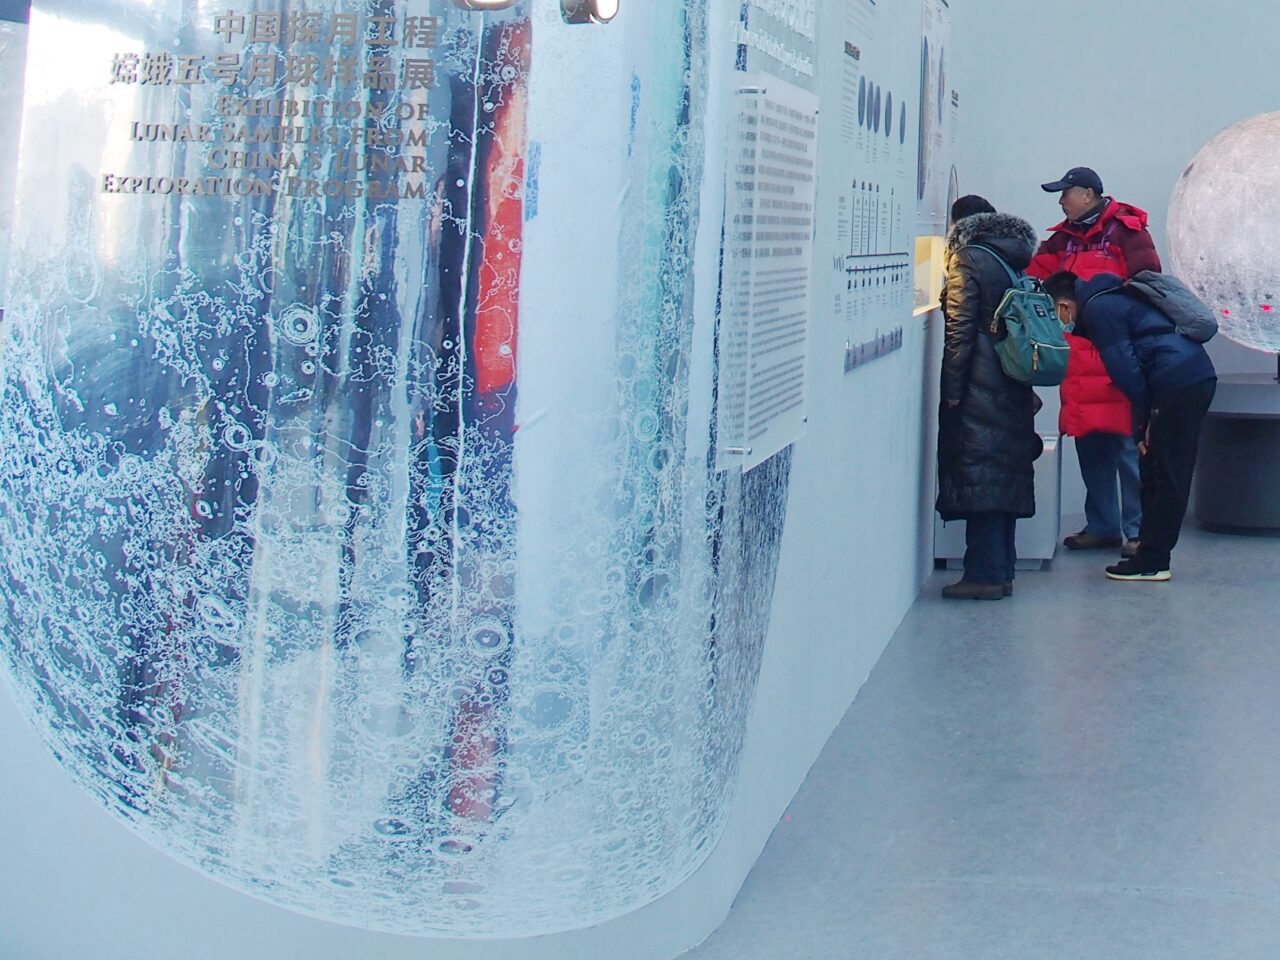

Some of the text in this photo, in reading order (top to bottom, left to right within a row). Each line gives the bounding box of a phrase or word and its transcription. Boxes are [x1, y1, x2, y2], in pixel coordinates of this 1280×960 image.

[213, 8, 439, 49] 中国探月工程
[108, 51, 436, 91] 嫦娥五号月球样品展
[217, 95, 430, 123] EXHIBITION OF
[129, 121, 429, 148] LUNAR SAMPLES FROM
[207, 147, 428, 175] CHINA'S LUNAR
[99, 173, 428, 201] EXPLORATION PROGRAM
